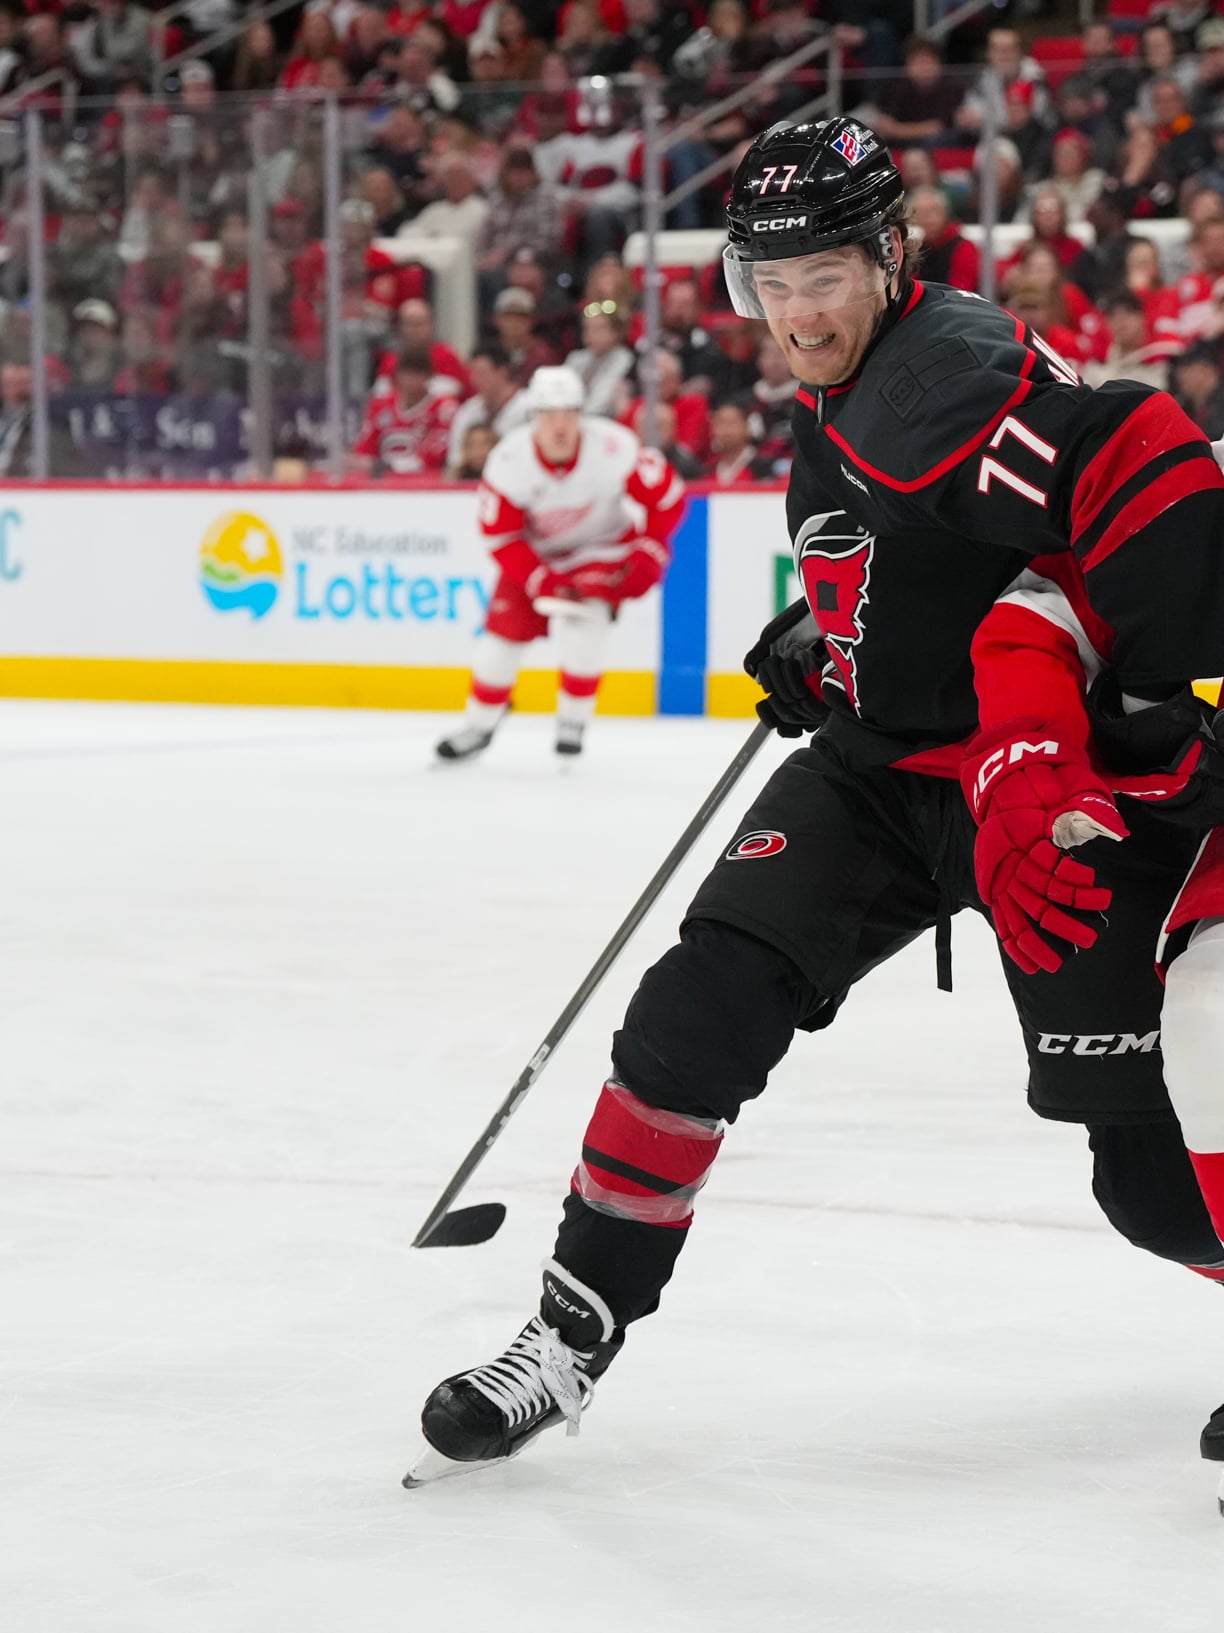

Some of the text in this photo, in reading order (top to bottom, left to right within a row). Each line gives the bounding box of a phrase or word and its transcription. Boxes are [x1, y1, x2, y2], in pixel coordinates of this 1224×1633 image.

[759, 164, 800, 195] 77
[752, 216, 807, 232] CCM
[977, 414, 1059, 509] 77
[291, 526, 449, 555] NC Education
[1037, 1030, 1160, 1056] CCM
[547, 1280, 591, 1319] CCM
